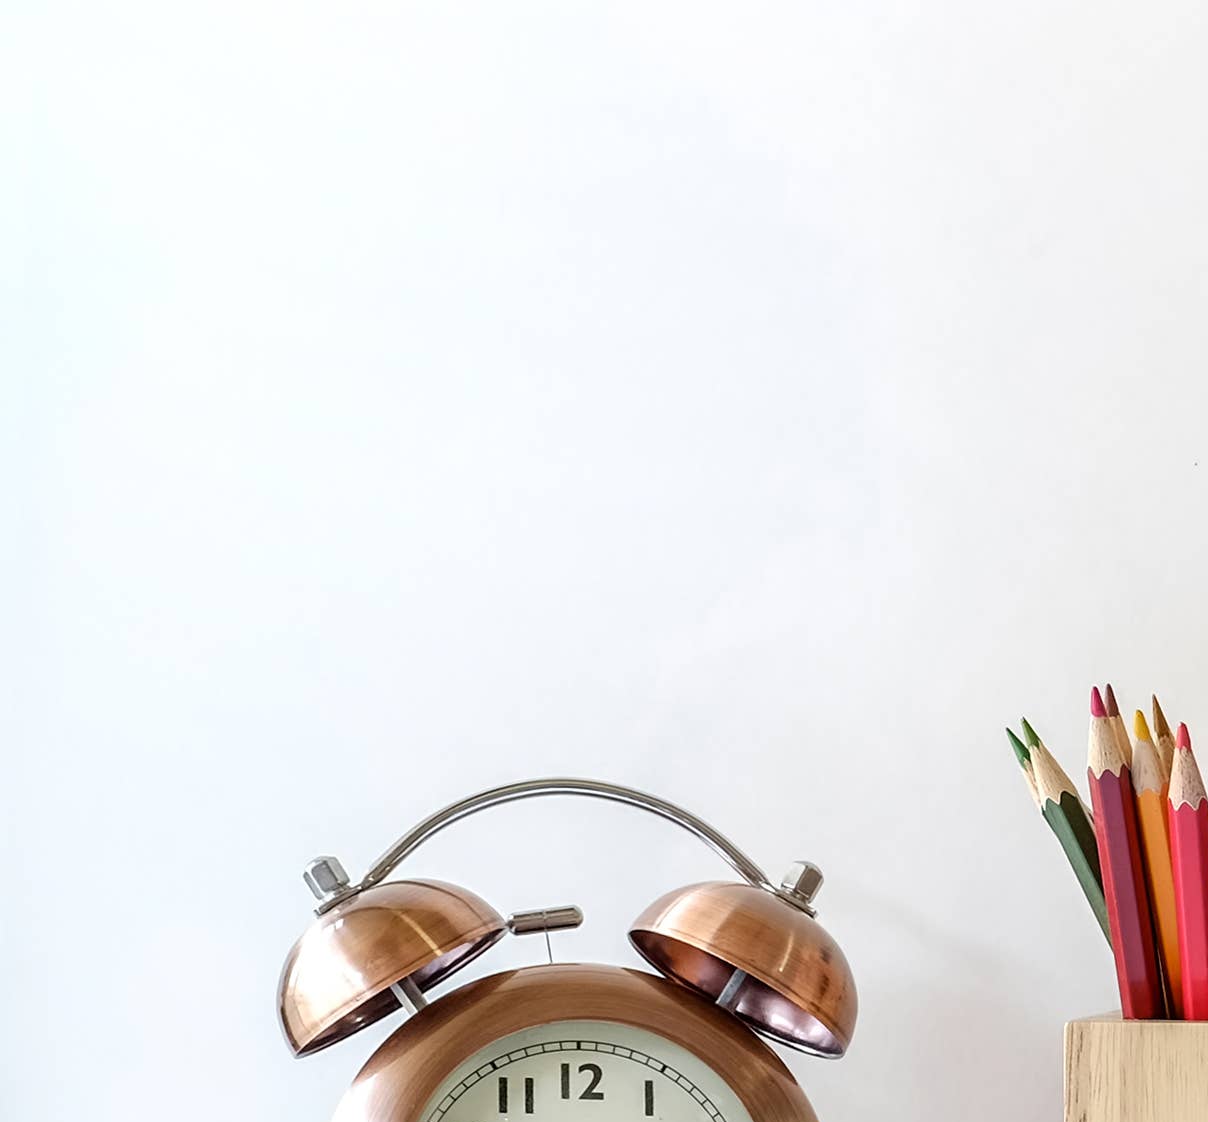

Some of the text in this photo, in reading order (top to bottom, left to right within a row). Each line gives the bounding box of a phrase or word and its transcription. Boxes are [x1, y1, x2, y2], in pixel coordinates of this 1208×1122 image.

[498, 1077, 534, 1114] 11
[560, 1063, 604, 1100] 12
[644, 1080, 654, 1116] 1
